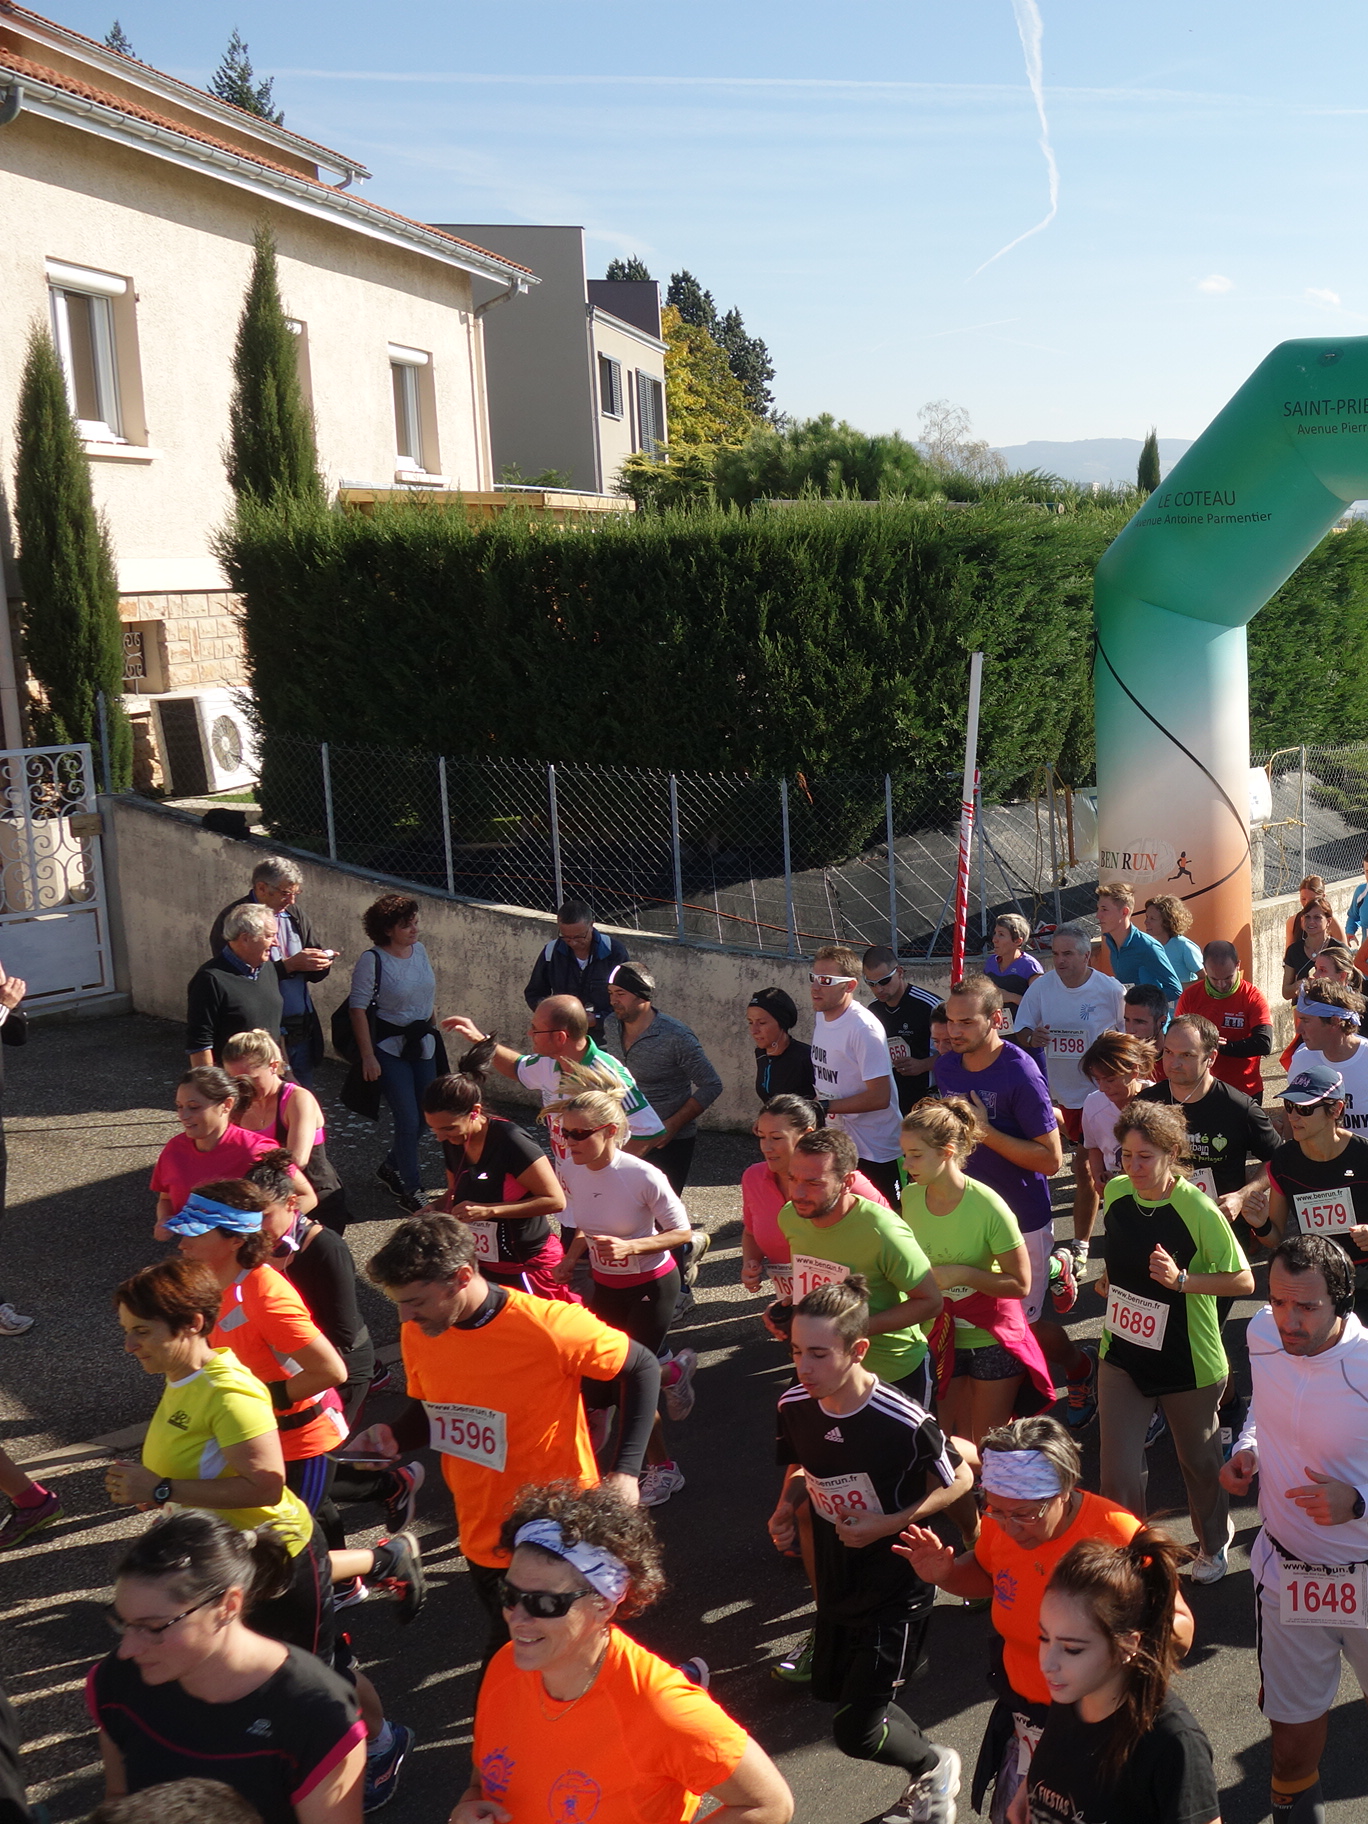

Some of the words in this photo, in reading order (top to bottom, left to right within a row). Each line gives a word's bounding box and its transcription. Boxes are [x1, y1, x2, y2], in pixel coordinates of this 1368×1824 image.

[1297, 424, 1338, 435] Avenue
[1158, 493, 1171, 508] LE
[1174, 490, 1236, 507] COTEAU
[1134, 516, 1162, 528] Avenue
[1164, 513, 1203, 525] Antoine
[1207, 512, 1272, 524] Parmentier
[1122, 852, 1158, 871] RUN
[890, 1044, 907, 1061] 658
[1052, 1037, 1084, 1053] 1598
[1296, 1189, 1343, 1202] www.benrun.fr
[1301, 1203, 1346, 1228] 1579
[796, 1257, 844, 1273] www.benrun.fr
[1111, 1286, 1161, 1310] www.benrun.fr
[1112, 1302, 1156, 1338] 1689
[427, 1403, 497, 1419] www.benrun.fr
[435, 1417, 496, 1454] 1596
[809, 1486, 868, 1516] 1688
[1286, 1580, 1356, 1614] 1648
[1038, 1784, 1071, 1816] FIESTAS
